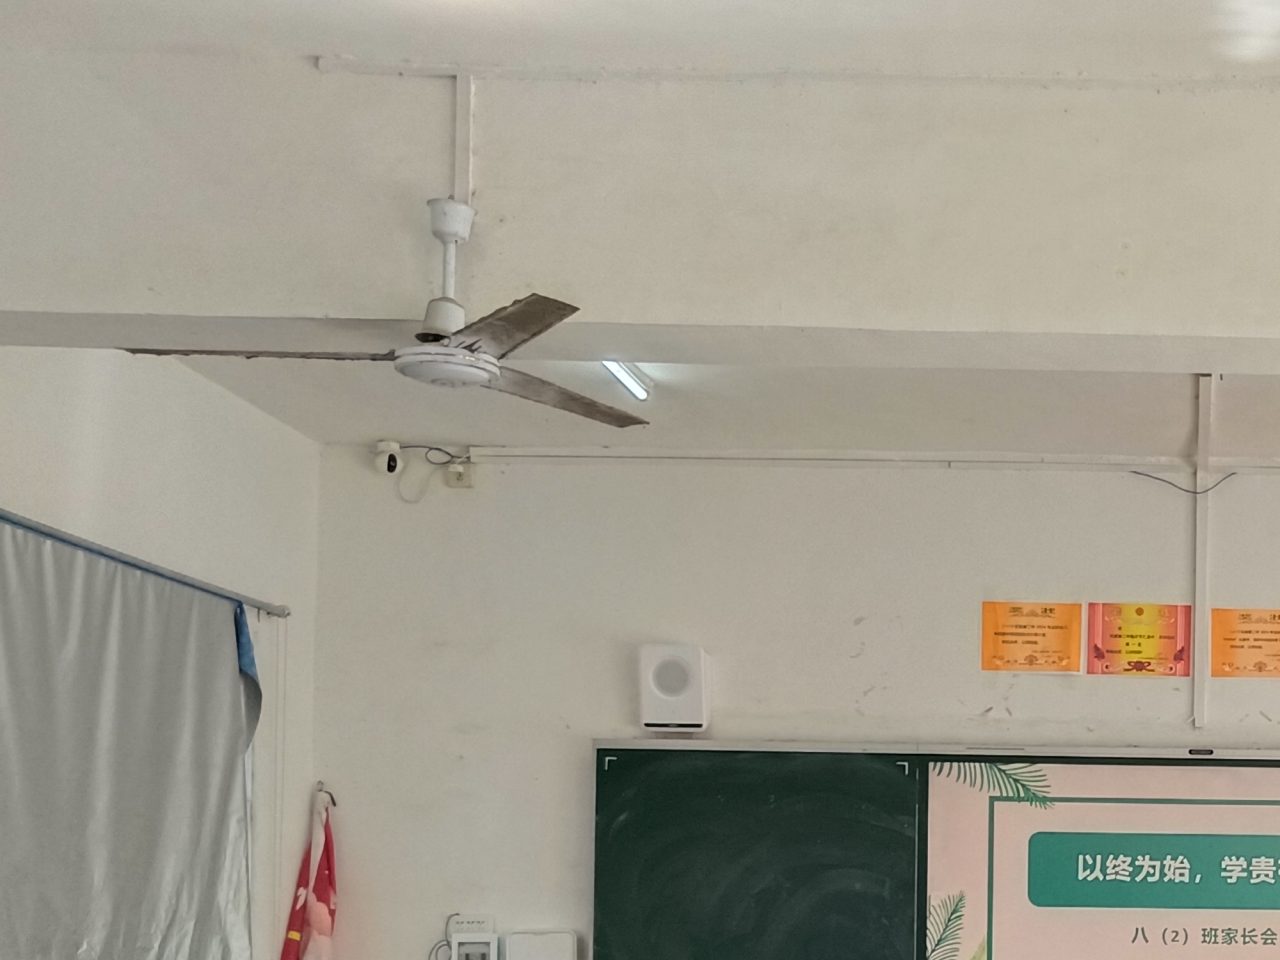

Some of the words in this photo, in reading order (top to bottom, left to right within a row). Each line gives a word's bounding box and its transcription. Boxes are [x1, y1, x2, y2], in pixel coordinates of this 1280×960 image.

[1130, 926, 1279, 947] 八（2）班家长会
